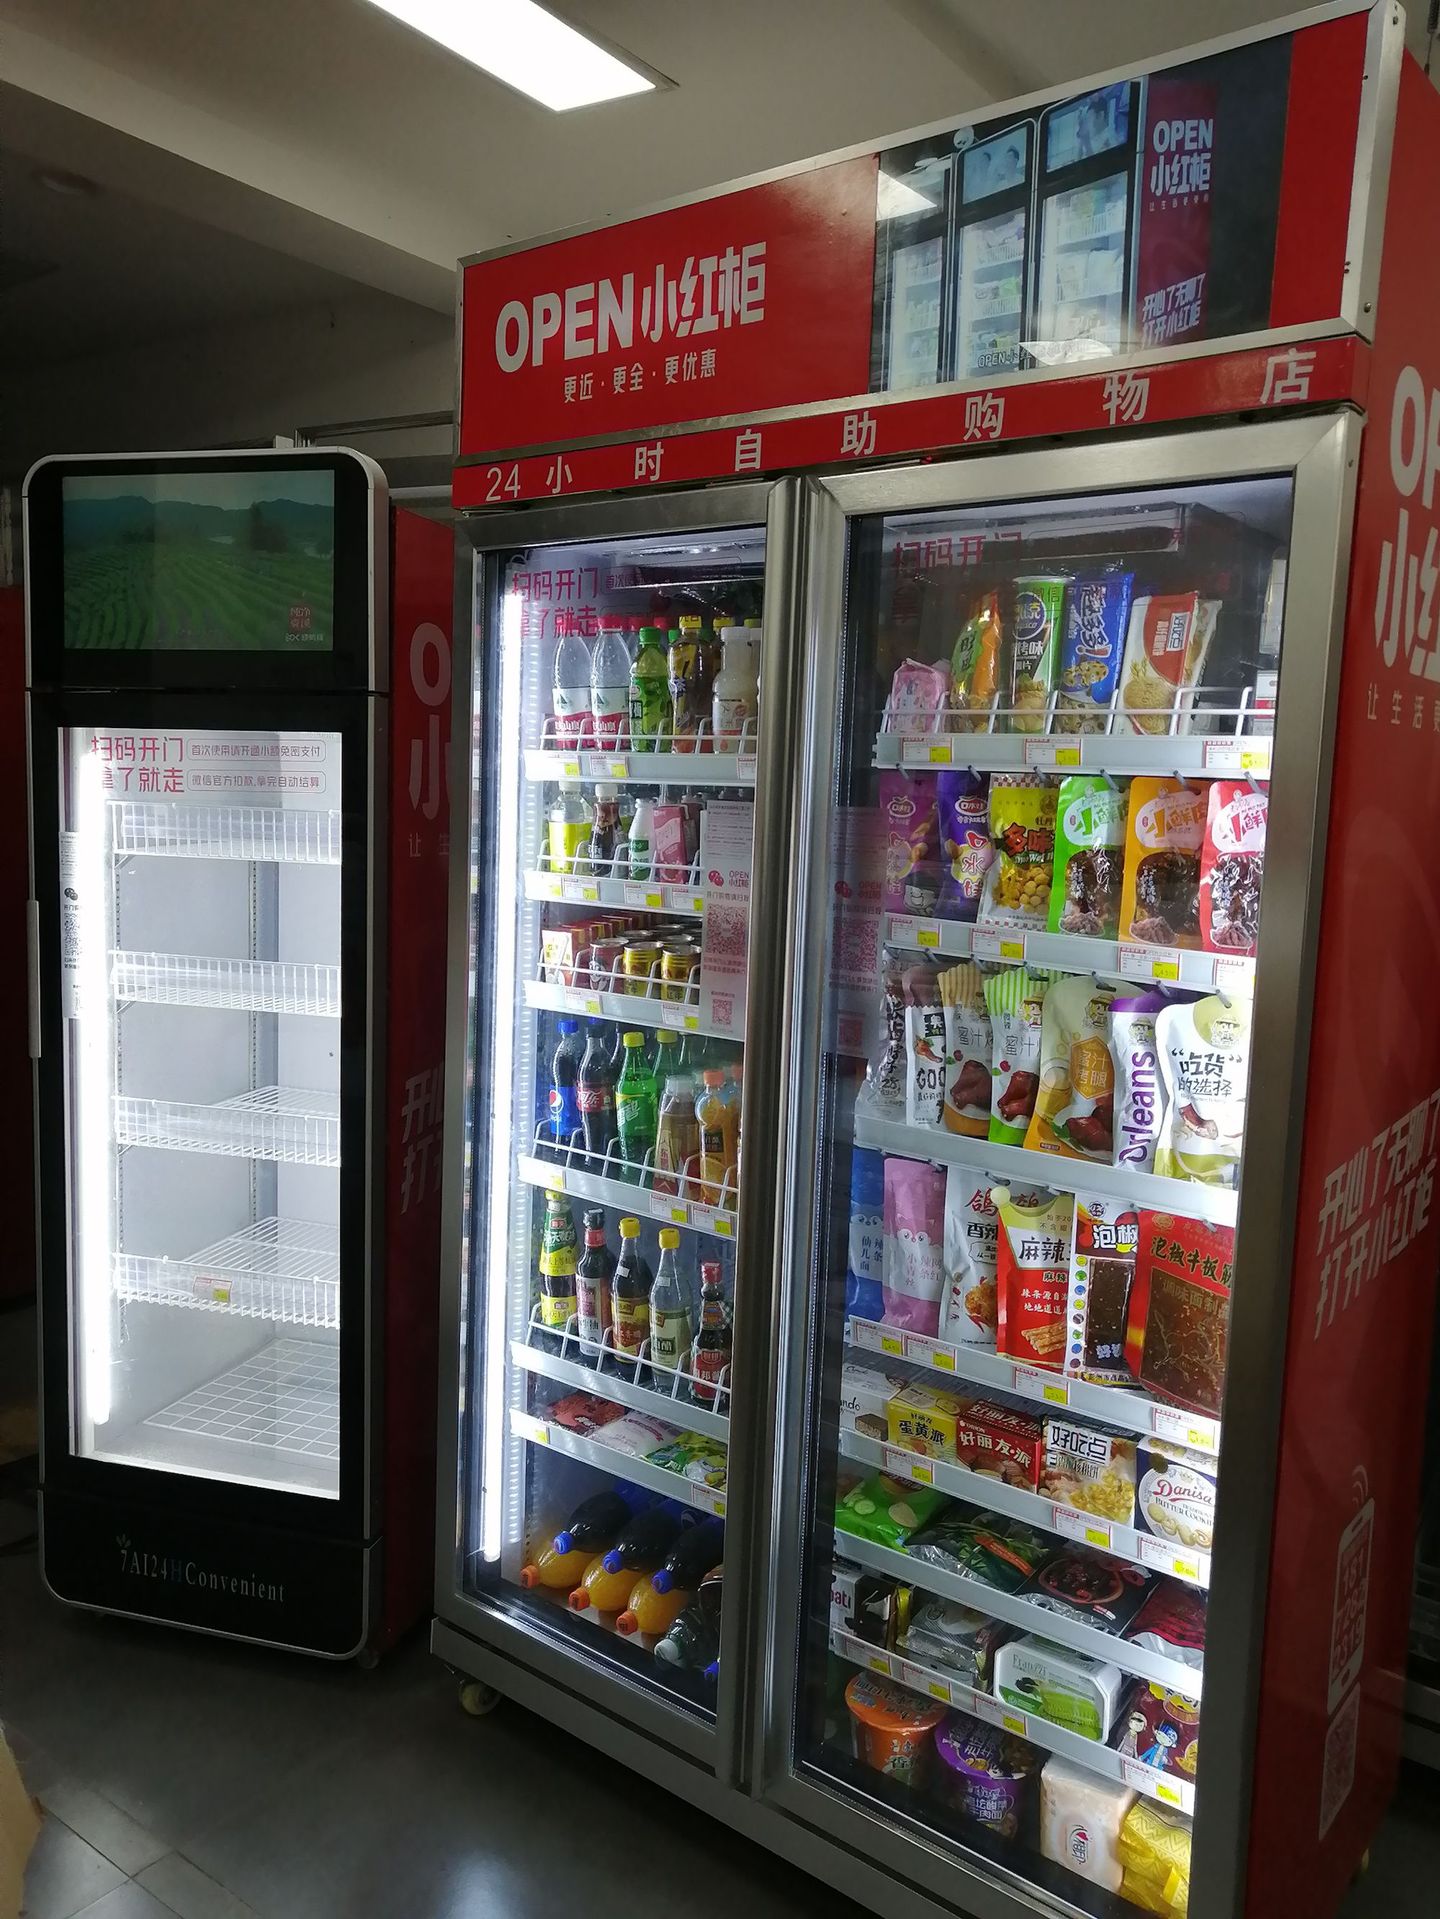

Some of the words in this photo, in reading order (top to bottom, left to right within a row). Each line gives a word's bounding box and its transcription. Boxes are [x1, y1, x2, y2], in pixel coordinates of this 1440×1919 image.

[1153, 119, 1213, 153] OPEN
[1151, 152, 1212, 196] 小红柜
[511, 566, 598, 600] 扫码开门
[91, 737, 184, 763] 扫码开门
[1177, 1077, 1233, 1096] 的选择
[1118, 1050, 1156, 1164] Orleans
[899, 1420, 946, 1446] 蛋黄派
[1051, 1425, 1108, 1460] 好吃点
[1152, 1477, 1214, 1505] Danisa
[1156, 1497, 1185, 1515] BUTTER
